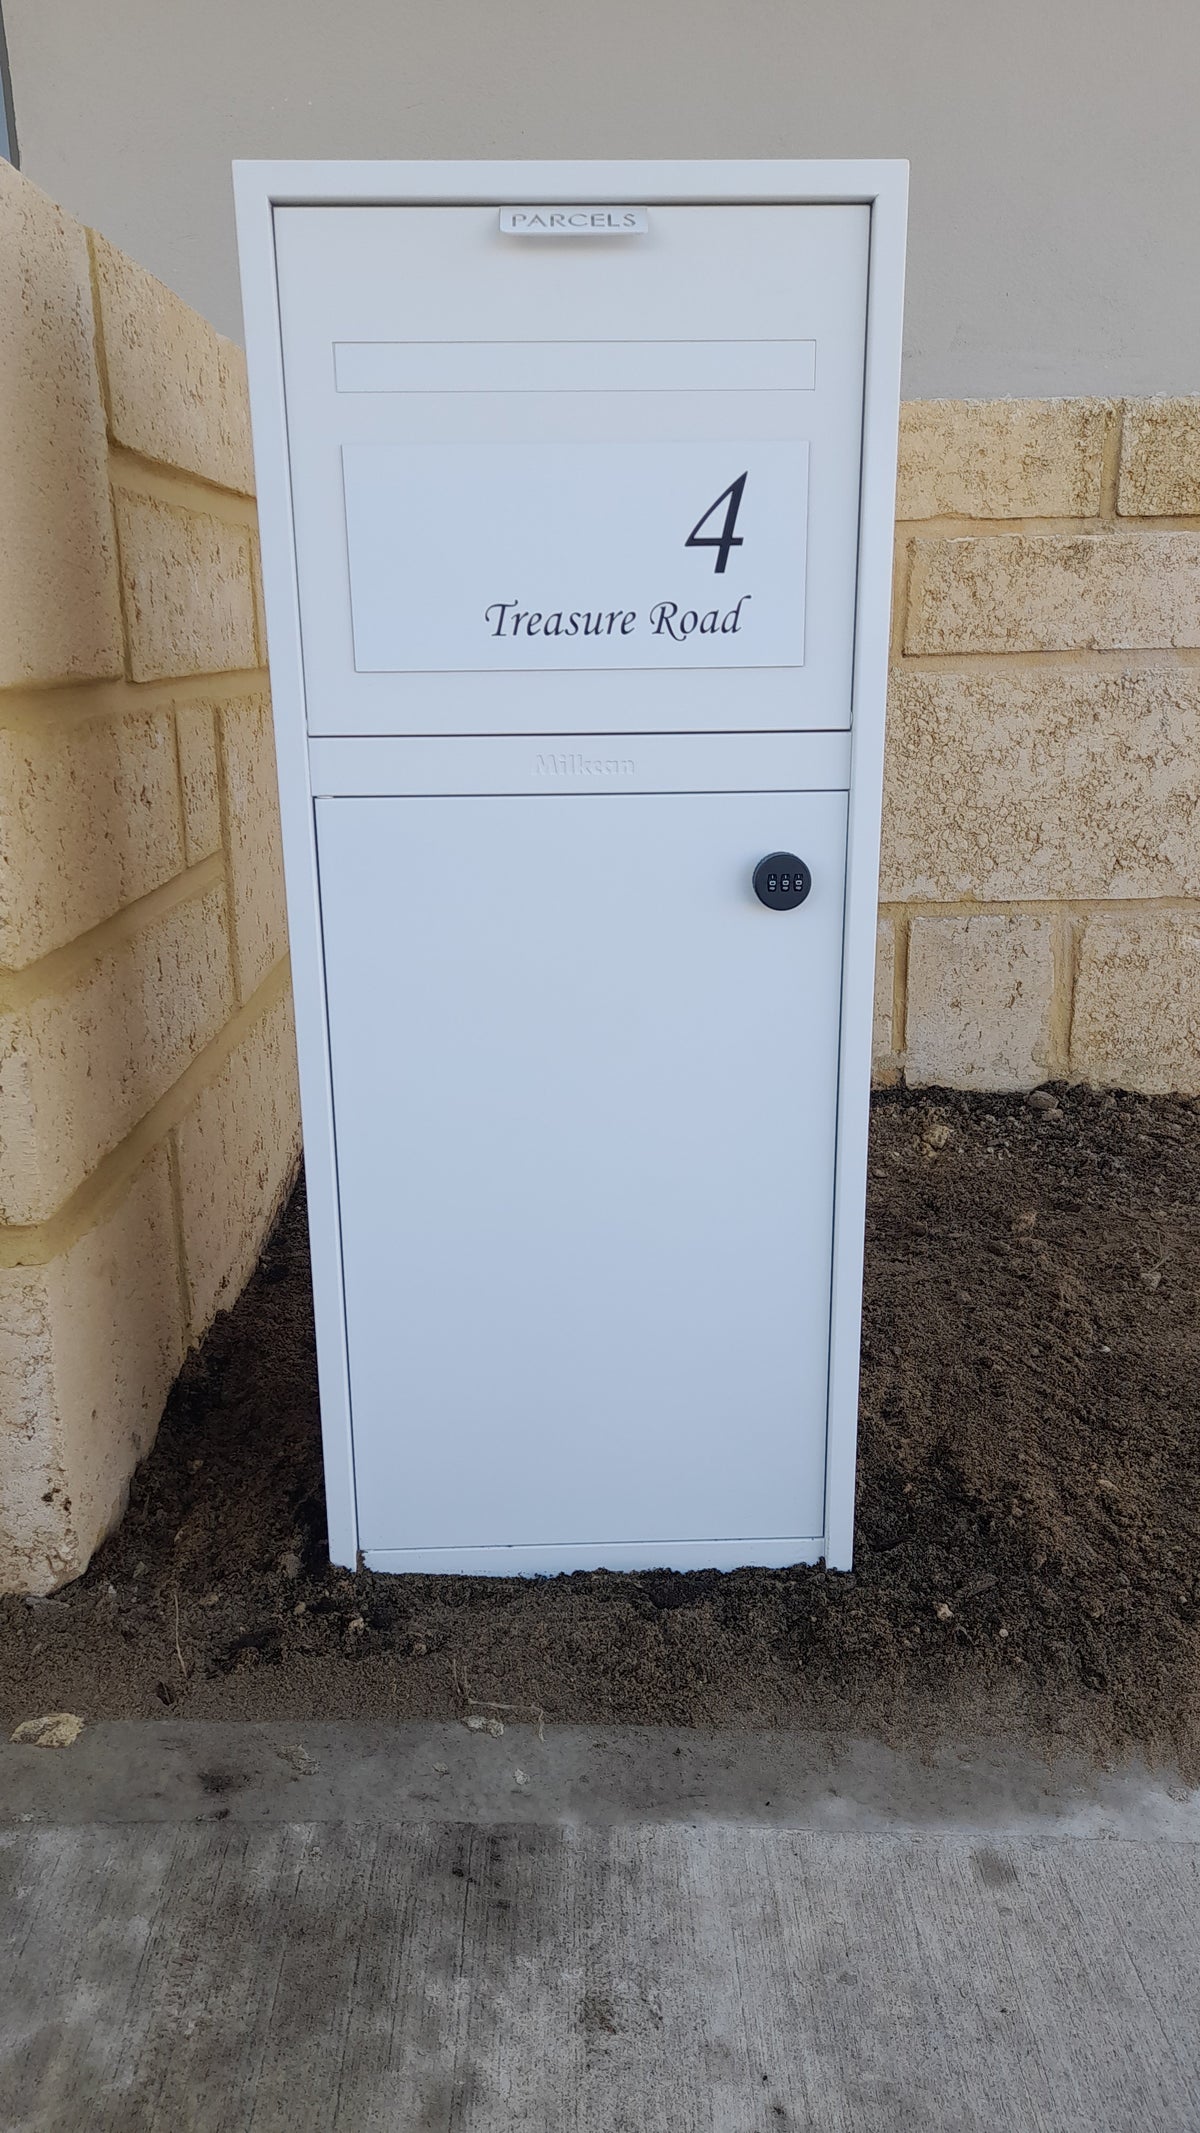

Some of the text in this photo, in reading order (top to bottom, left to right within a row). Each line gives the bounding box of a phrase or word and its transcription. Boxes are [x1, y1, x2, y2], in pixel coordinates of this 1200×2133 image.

[511, 213, 637, 228] PARCELS
[684, 470, 749, 574] 4
[484, 594, 752, 642] Treasure Road
